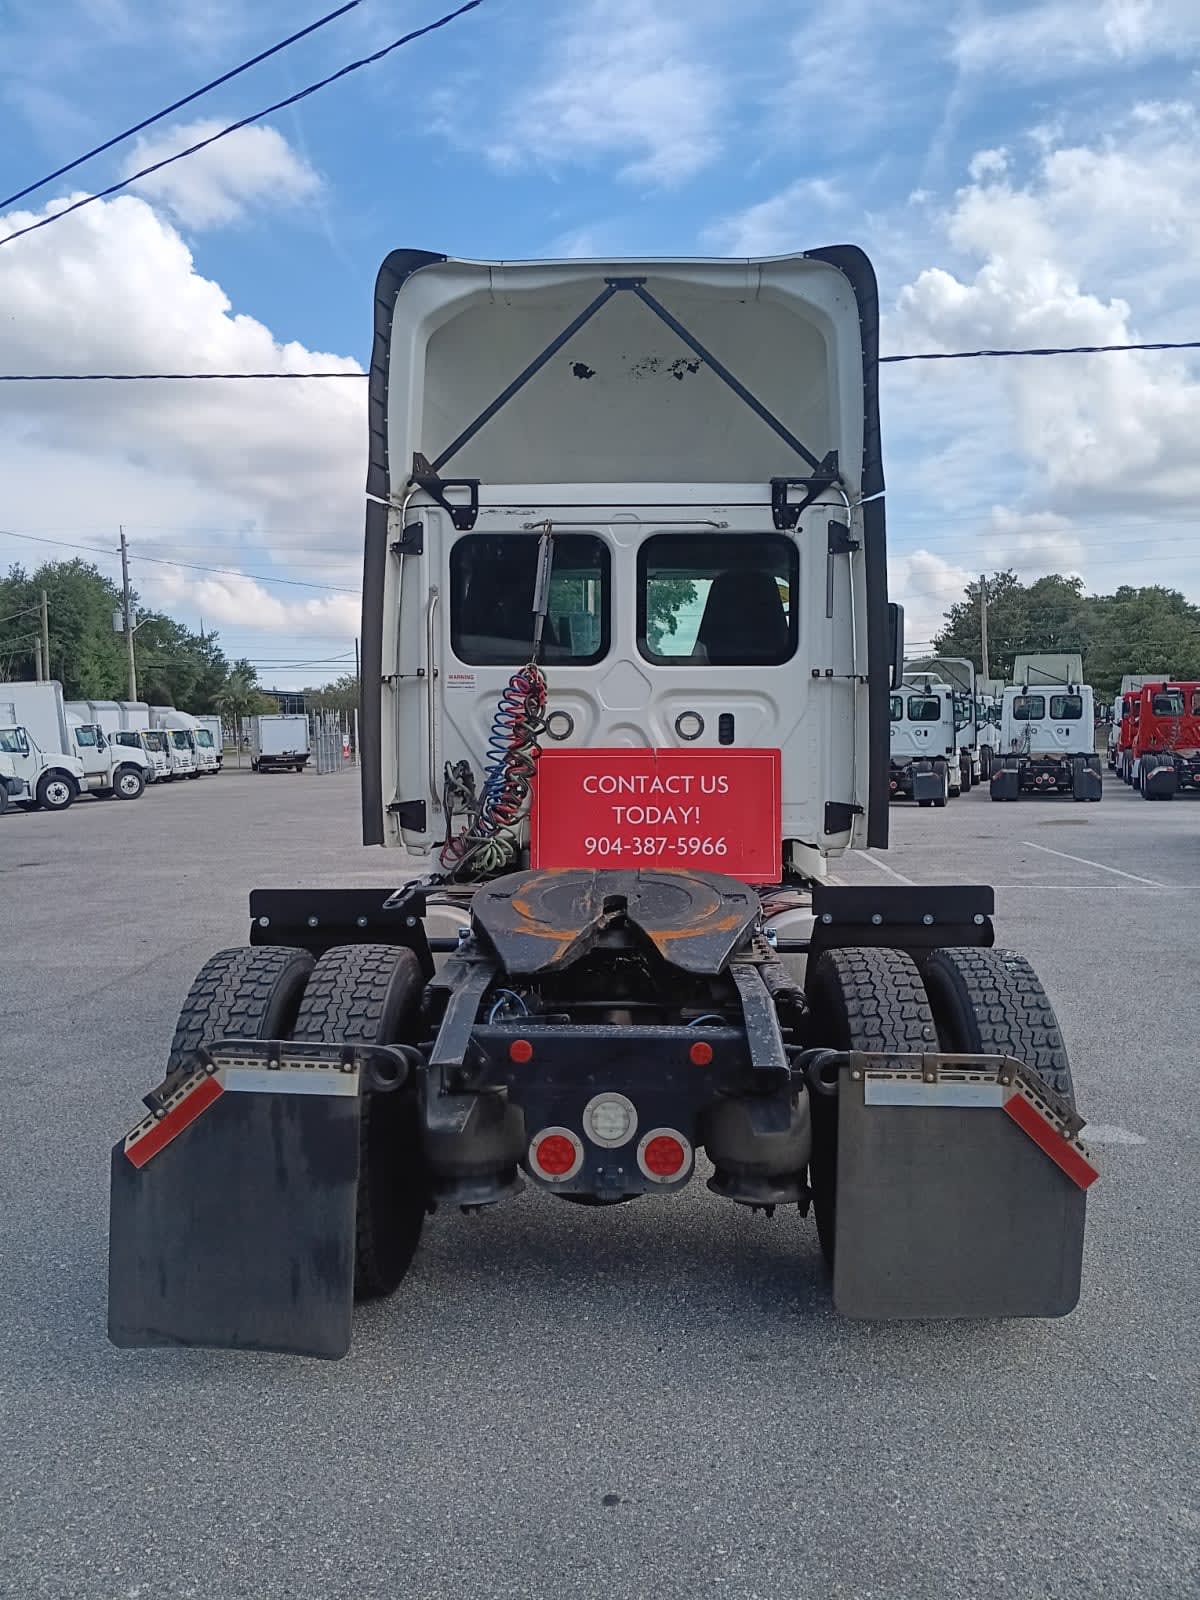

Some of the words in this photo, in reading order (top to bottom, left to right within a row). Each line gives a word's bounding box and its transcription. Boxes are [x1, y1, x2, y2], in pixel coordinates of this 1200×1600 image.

[583, 775, 695, 794] CONTACT
[700, 775, 729, 794] US
[611, 806, 701, 825] TODAY!
[584, 836, 728, 856] 904-387-5966
